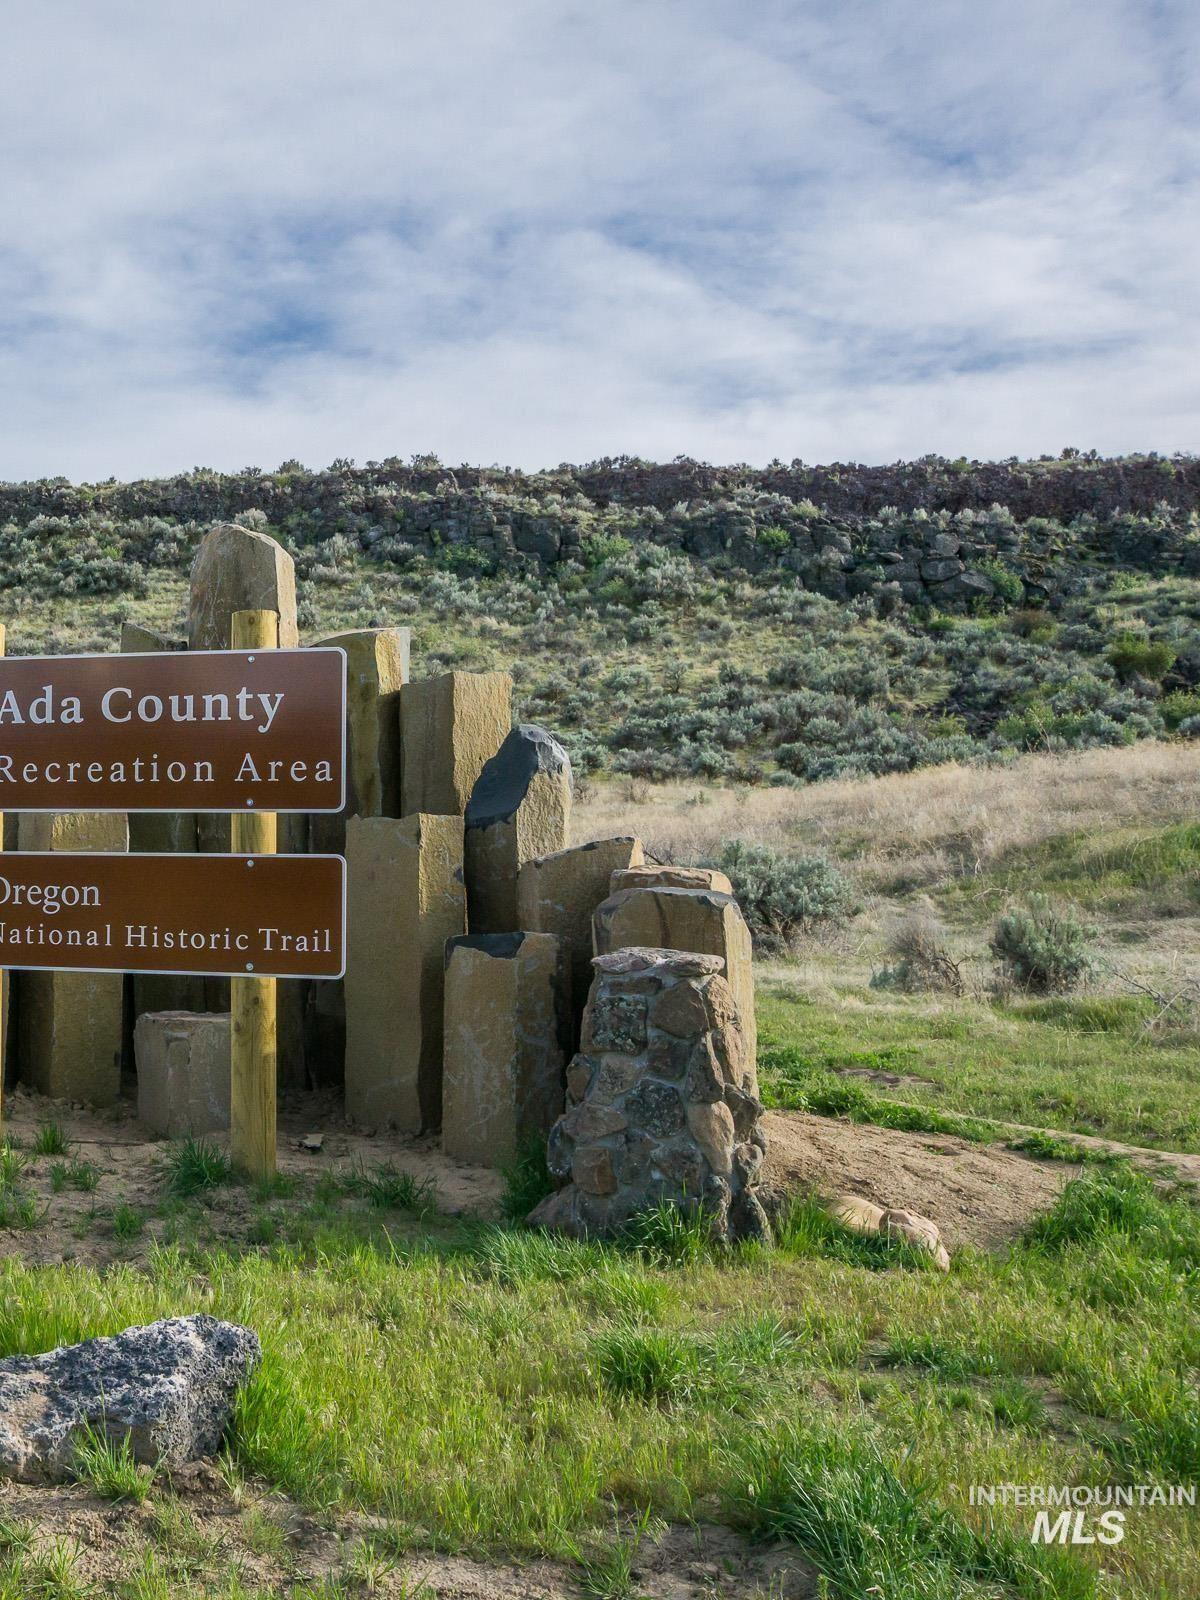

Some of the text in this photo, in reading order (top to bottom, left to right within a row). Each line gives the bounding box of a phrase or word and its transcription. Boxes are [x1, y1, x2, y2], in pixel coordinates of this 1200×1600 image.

[101, 686, 284, 734] County
[235, 752, 333, 782] Area
[125, 925, 249, 951] Historic
[258, 928, 331, 953] Trail
